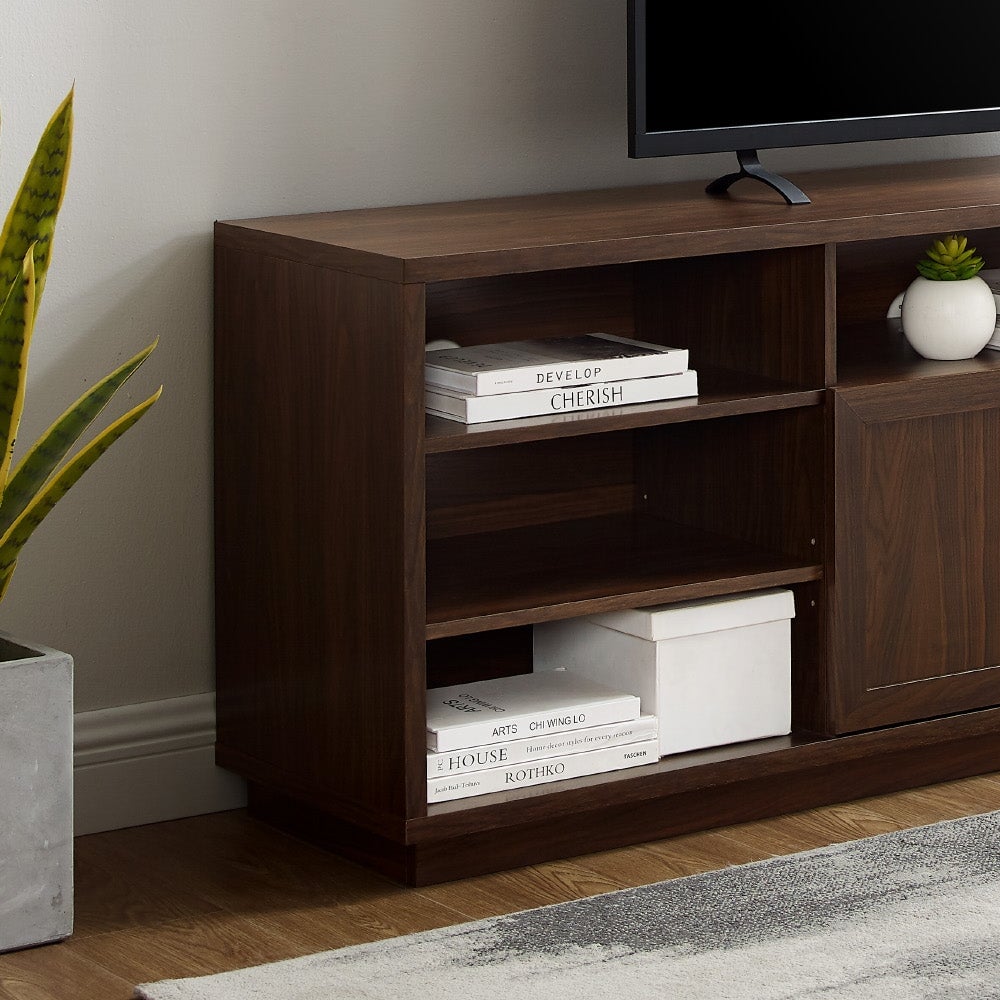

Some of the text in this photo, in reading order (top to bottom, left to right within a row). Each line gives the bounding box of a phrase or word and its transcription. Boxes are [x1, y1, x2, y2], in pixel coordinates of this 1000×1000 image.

[536, 367, 602, 384] DEVELOP
[550, 386, 624, 410] CHERISH
[492, 713, 586, 737] ARTS CHI WING LO
[449, 748, 508, 770] HOUSE
[526, 745, 546, 753] Home
[566, 738, 583, 747] styles
[594, 733, 612, 741] every
[505, 762, 565, 784] ROTHKO
[623, 750, 647, 759] TASCHEN
